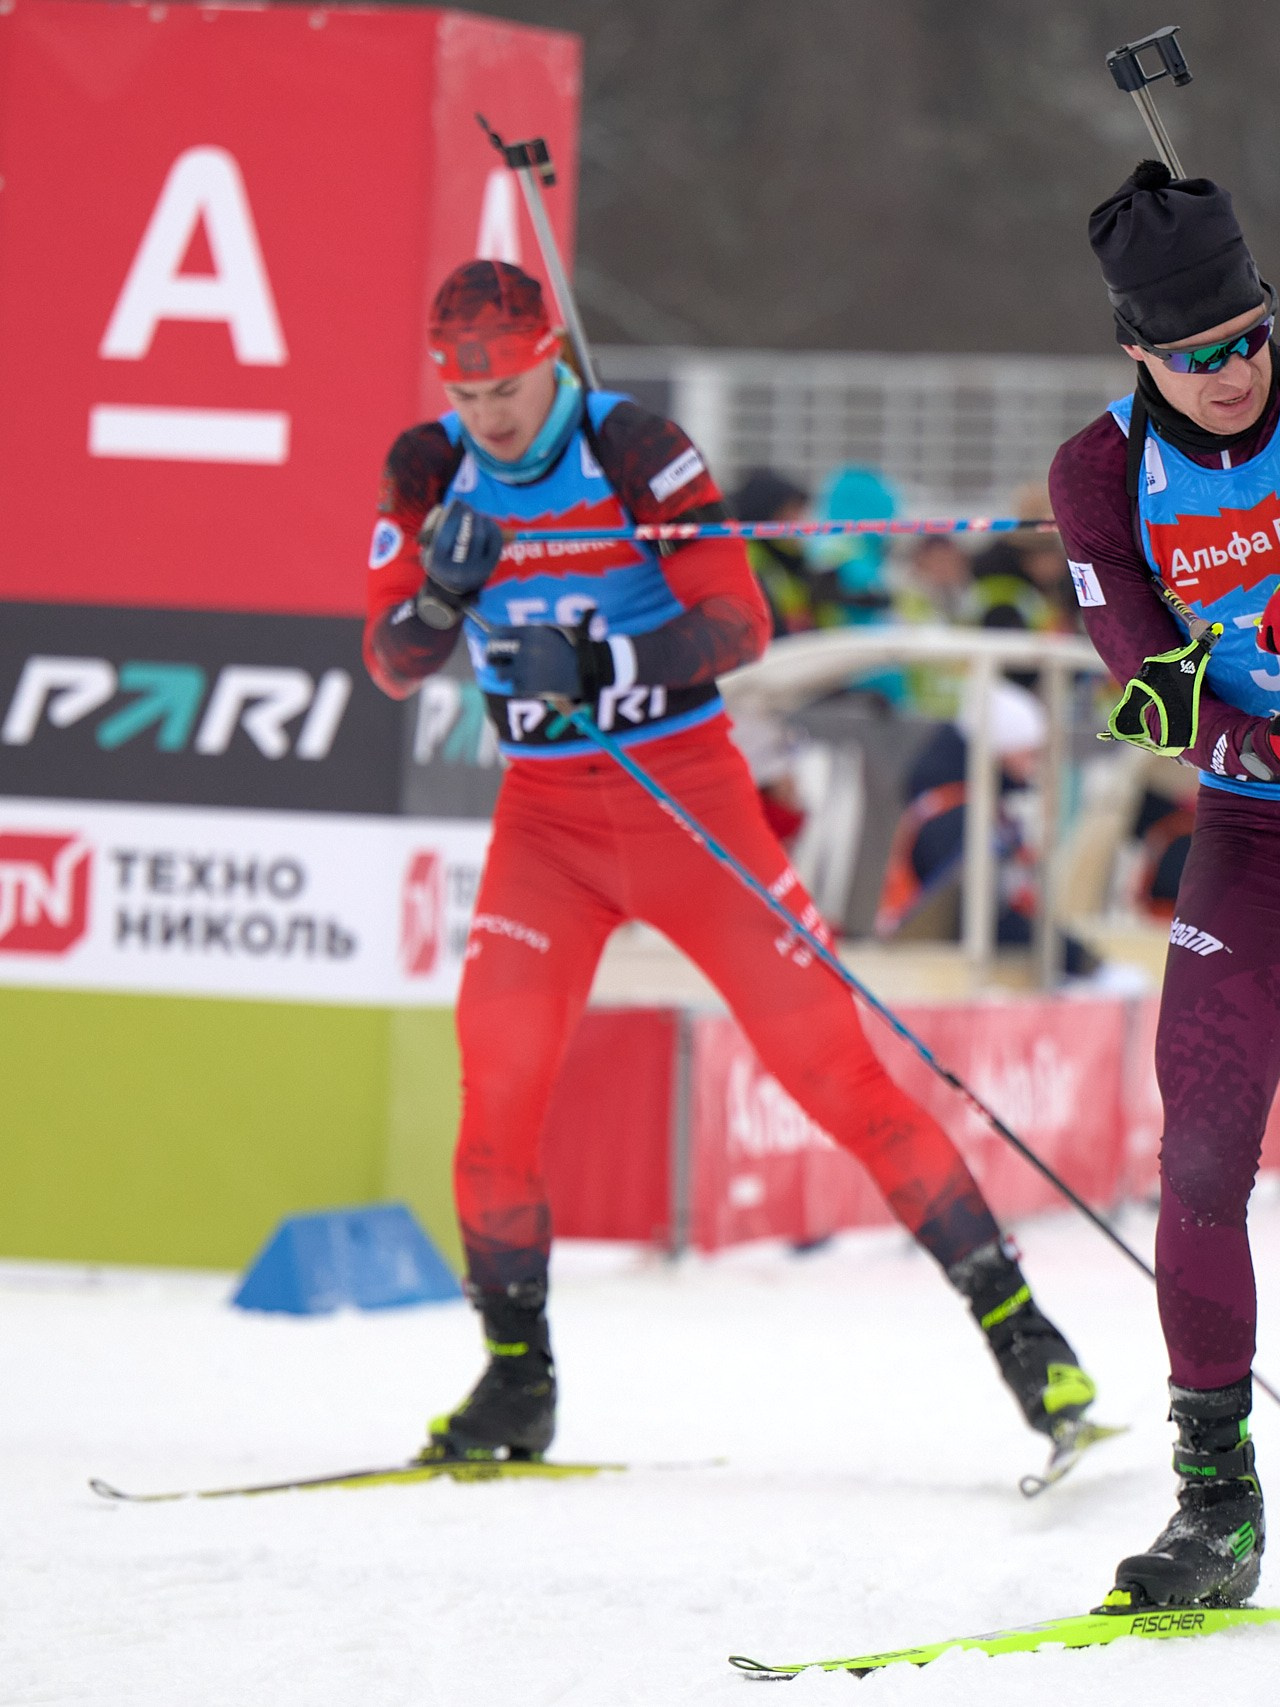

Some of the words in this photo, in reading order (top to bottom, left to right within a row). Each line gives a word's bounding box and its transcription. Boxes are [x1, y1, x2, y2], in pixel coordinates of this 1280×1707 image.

[1170, 531, 1273, 579] Альфа
[2, 657, 352, 760] PARI
[112, 850, 306, 899] ТЕХНО
[116, 911, 356, 961] НИКОЛЬ
[1130, 1613, 1205, 1635] FISCHER
